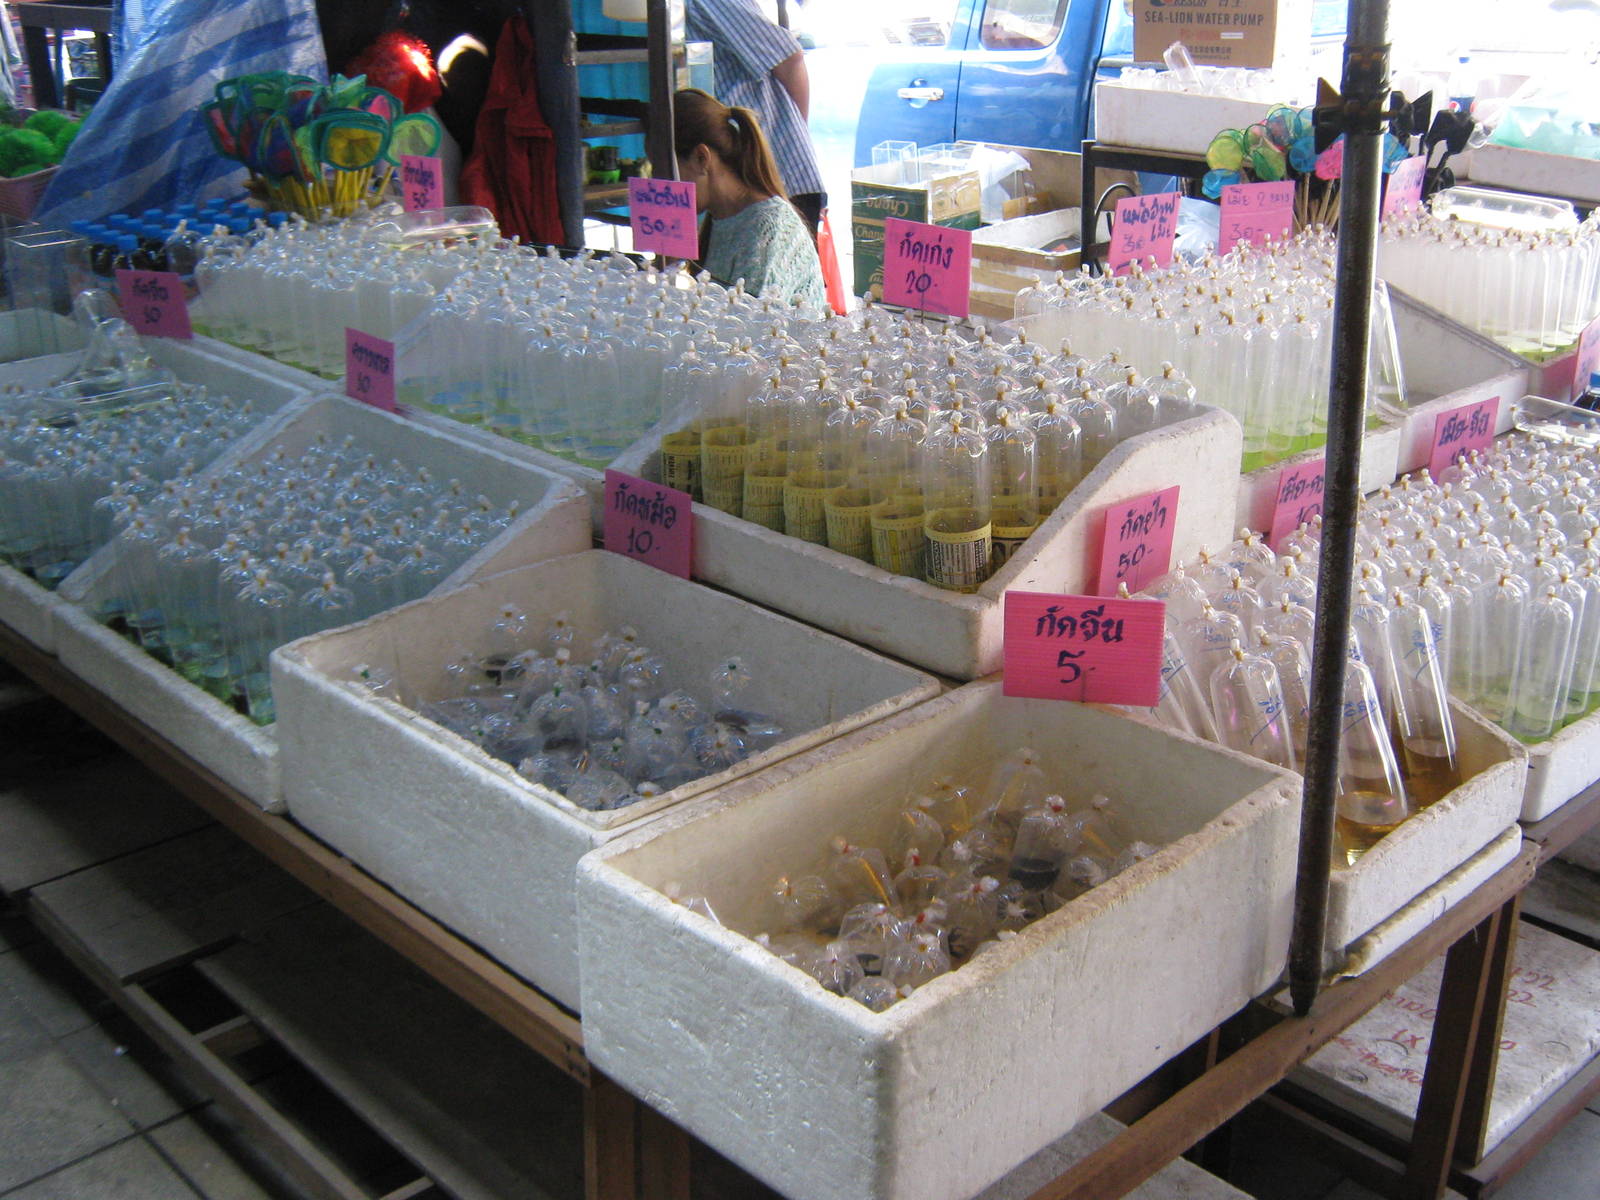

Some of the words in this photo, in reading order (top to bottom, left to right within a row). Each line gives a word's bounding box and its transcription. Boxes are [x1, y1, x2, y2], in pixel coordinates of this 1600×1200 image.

[1144, 10, 1193, 24] SEA-LION
[1196, 12, 1230, 25] WATER
[1233, 13, 1264, 26] PUMP
[899, 231, 954, 270] กัดเก่ง
[614, 482, 677, 530] กัดหม้อ
[1035, 604, 1125, 643] กัดจีน
